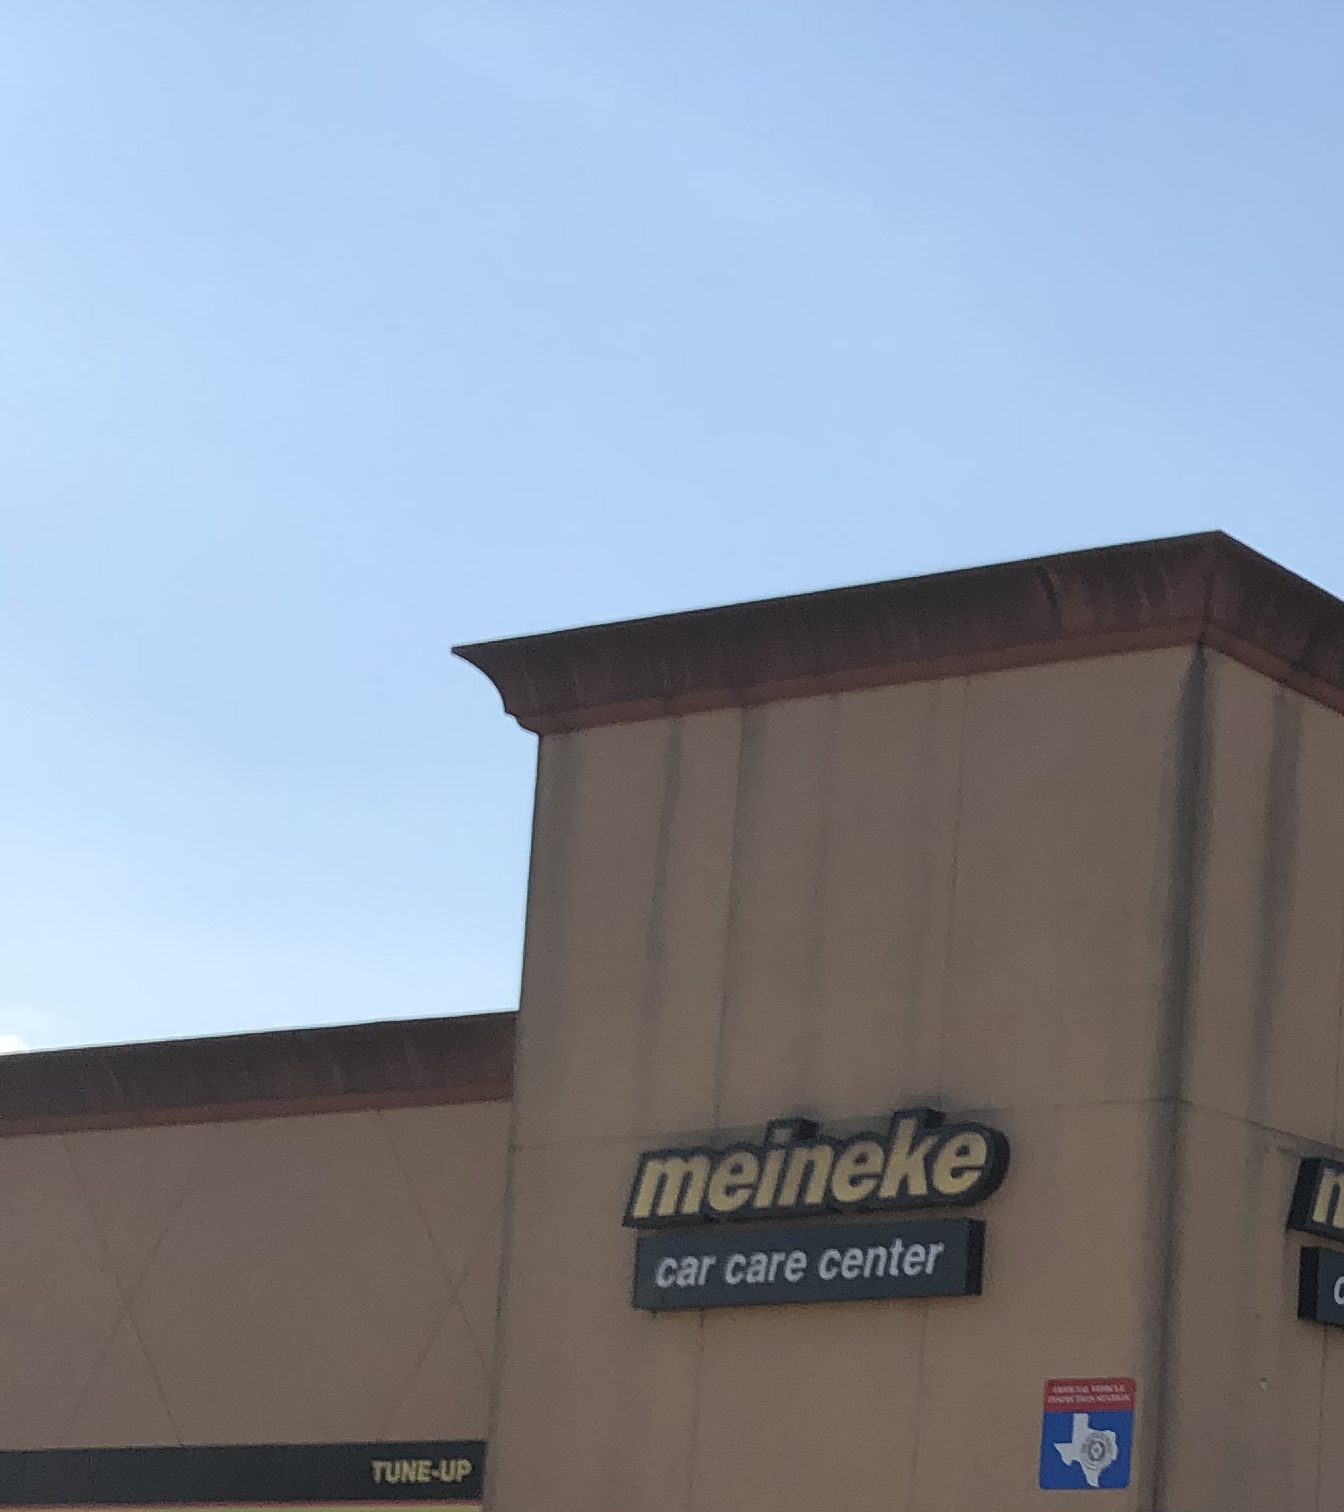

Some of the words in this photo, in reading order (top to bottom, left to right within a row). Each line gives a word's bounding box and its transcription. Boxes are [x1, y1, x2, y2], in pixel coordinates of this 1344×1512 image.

[632, 1117, 988, 1219] meineke
[655, 1253, 715, 1288] car
[724, 1250, 807, 1285] care
[819, 1239, 944, 1280] center
[371, 1459, 472, 1484] TUNE-UP
